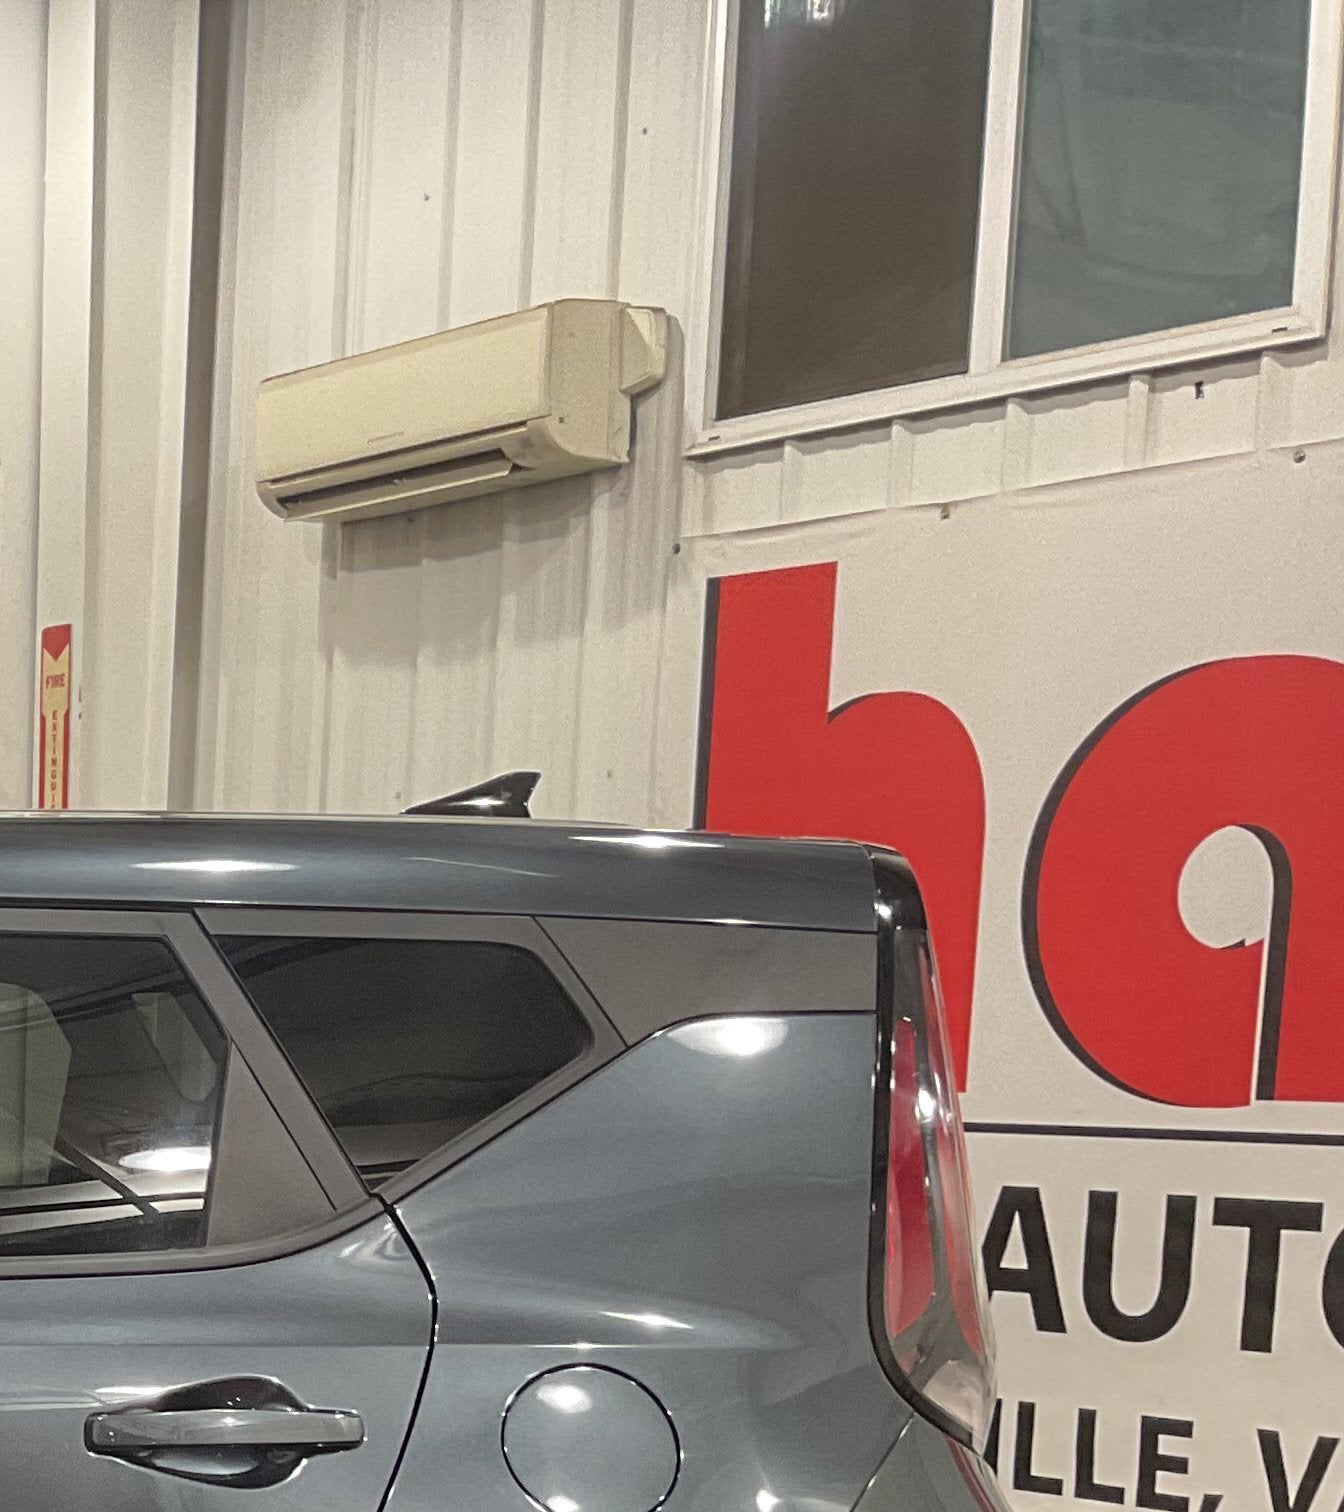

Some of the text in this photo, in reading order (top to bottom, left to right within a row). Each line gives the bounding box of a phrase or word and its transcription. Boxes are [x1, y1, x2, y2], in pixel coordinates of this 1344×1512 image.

[45, 673, 66, 689] FIRE
[50, 709, 58, 808] EXTINGUI
[981, 1185, 1344, 1353] AUT
